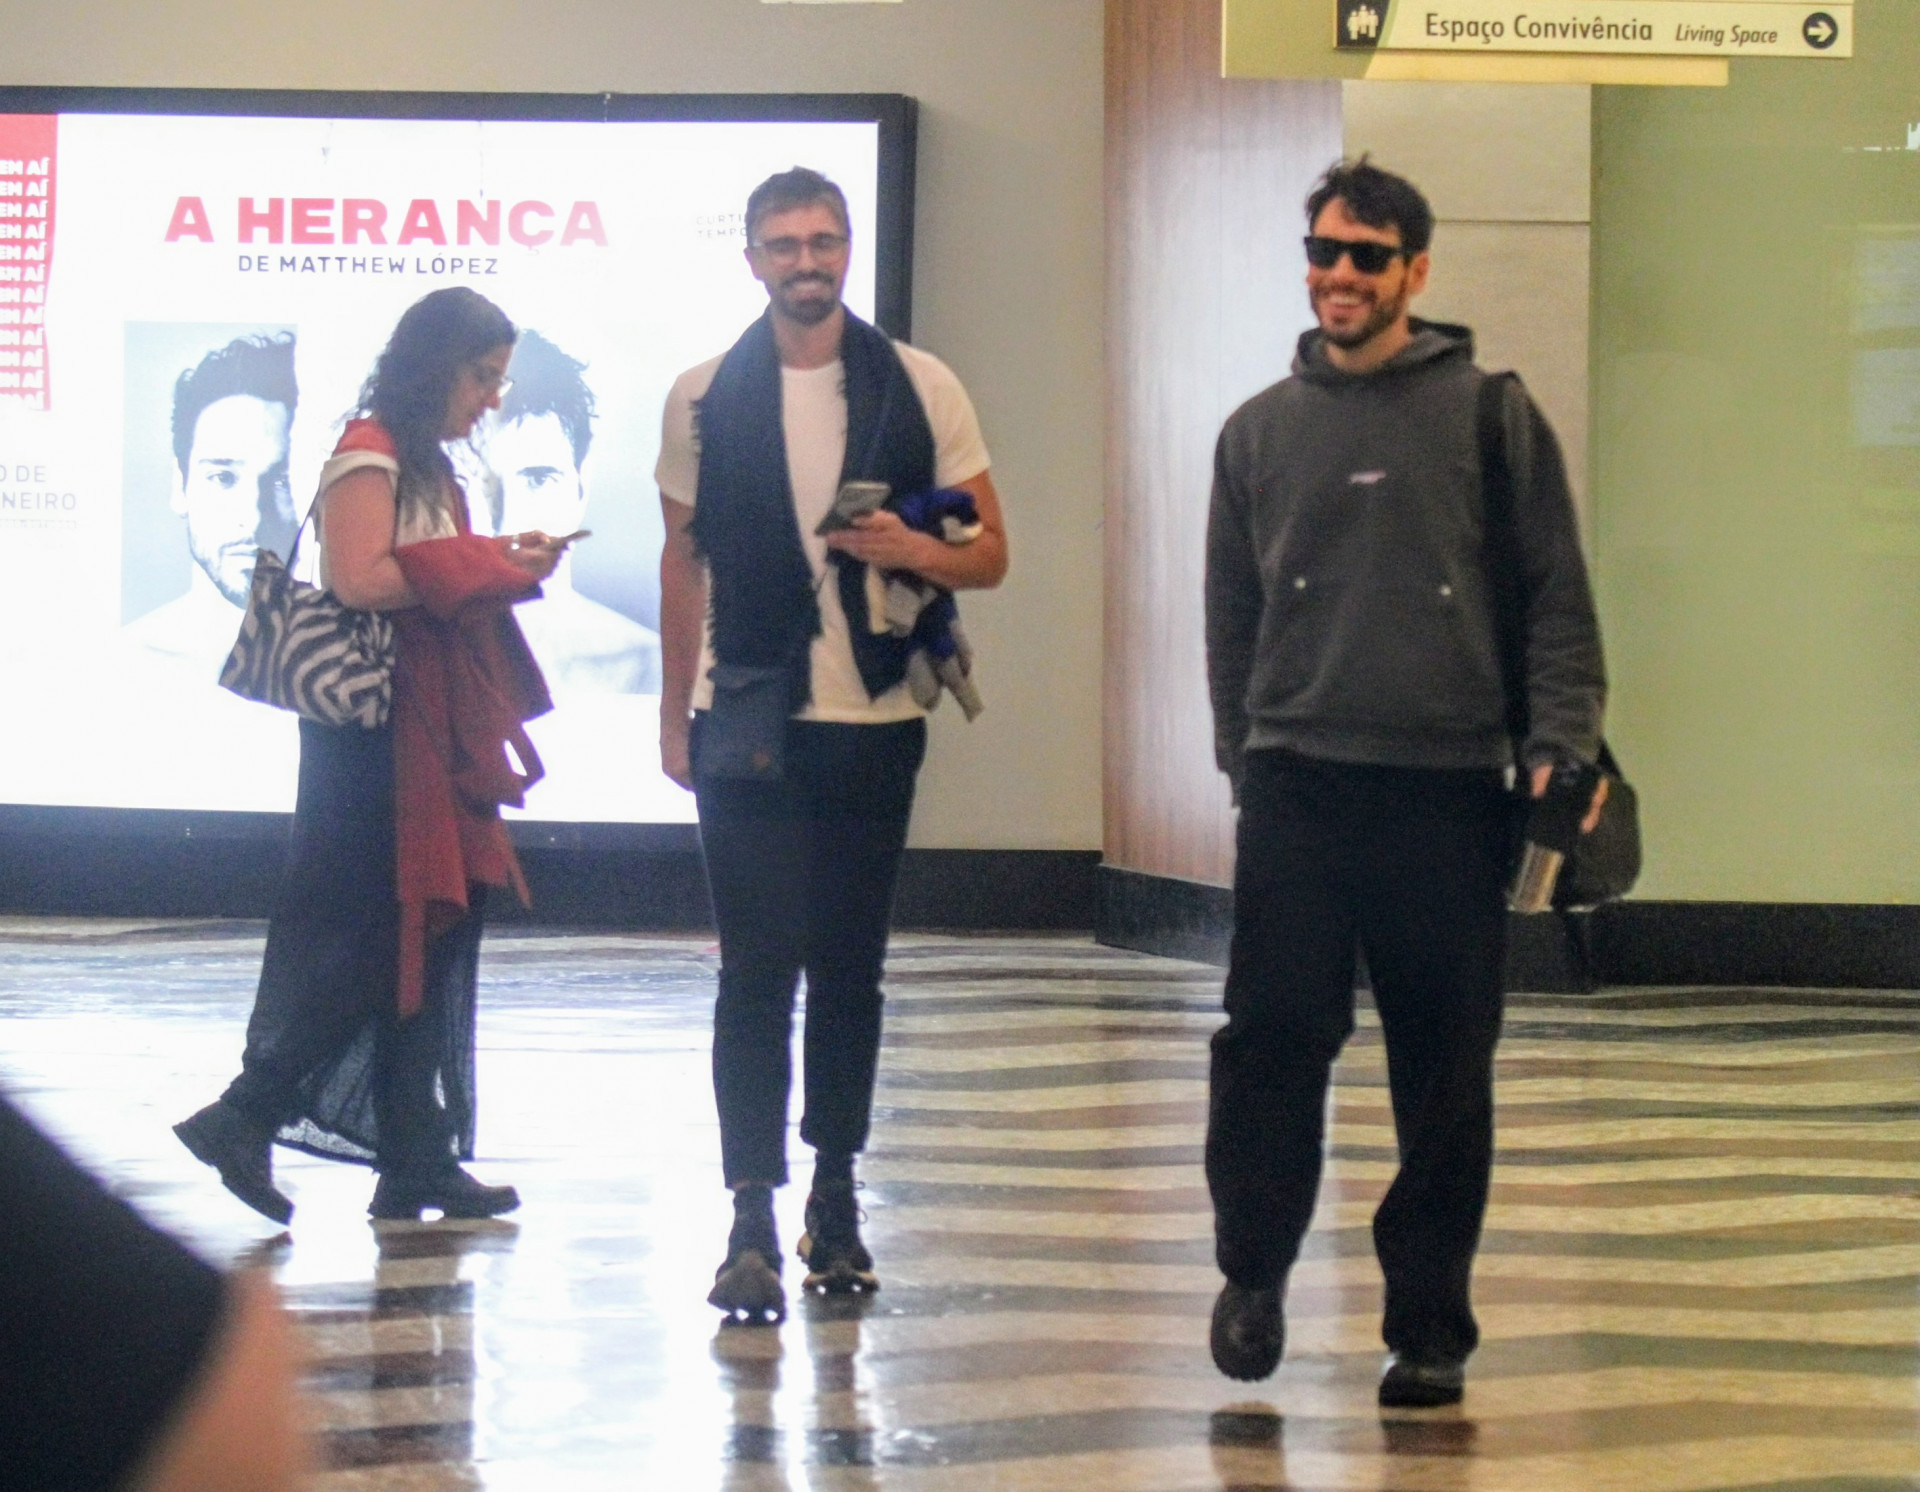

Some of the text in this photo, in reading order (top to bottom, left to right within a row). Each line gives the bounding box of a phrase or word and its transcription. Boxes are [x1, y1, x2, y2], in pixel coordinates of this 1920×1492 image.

[1426, 13, 1778, 46] Espaço Convivência Living Space
[164, 197, 608, 254] A HERANÇA
[238, 253, 499, 274] DE MATTHEW LÓPEZ
[16, 465, 46, 482] DE
